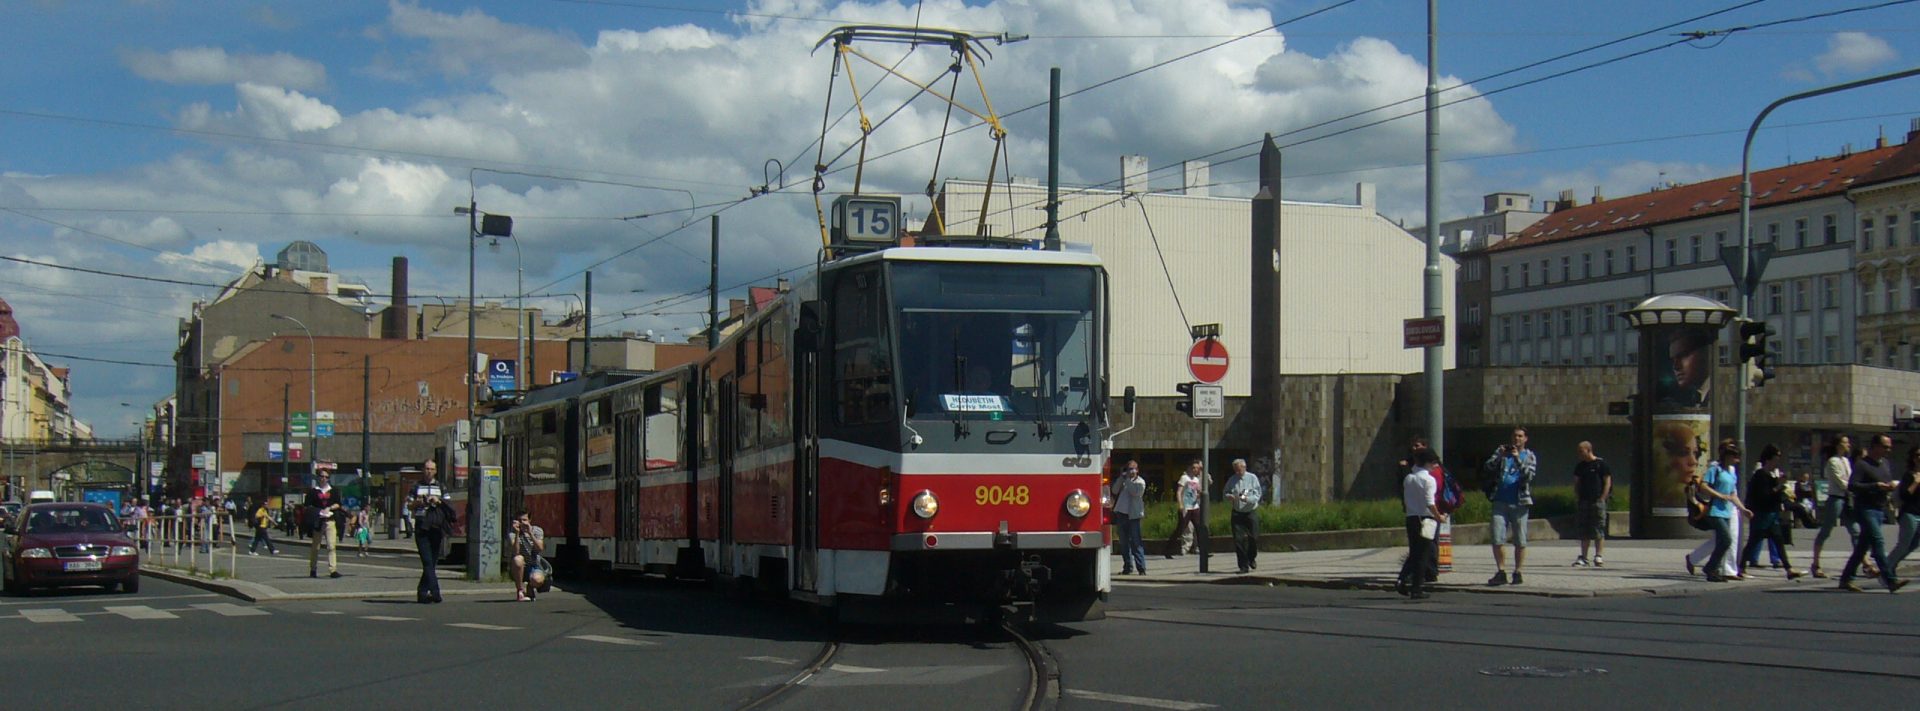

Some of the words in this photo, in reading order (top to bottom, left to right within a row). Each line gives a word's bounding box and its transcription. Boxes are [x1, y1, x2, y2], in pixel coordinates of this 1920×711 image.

[851, 207, 889, 235] 15
[496, 361, 510, 374] O2
[974, 485, 1030, 506] 9048
